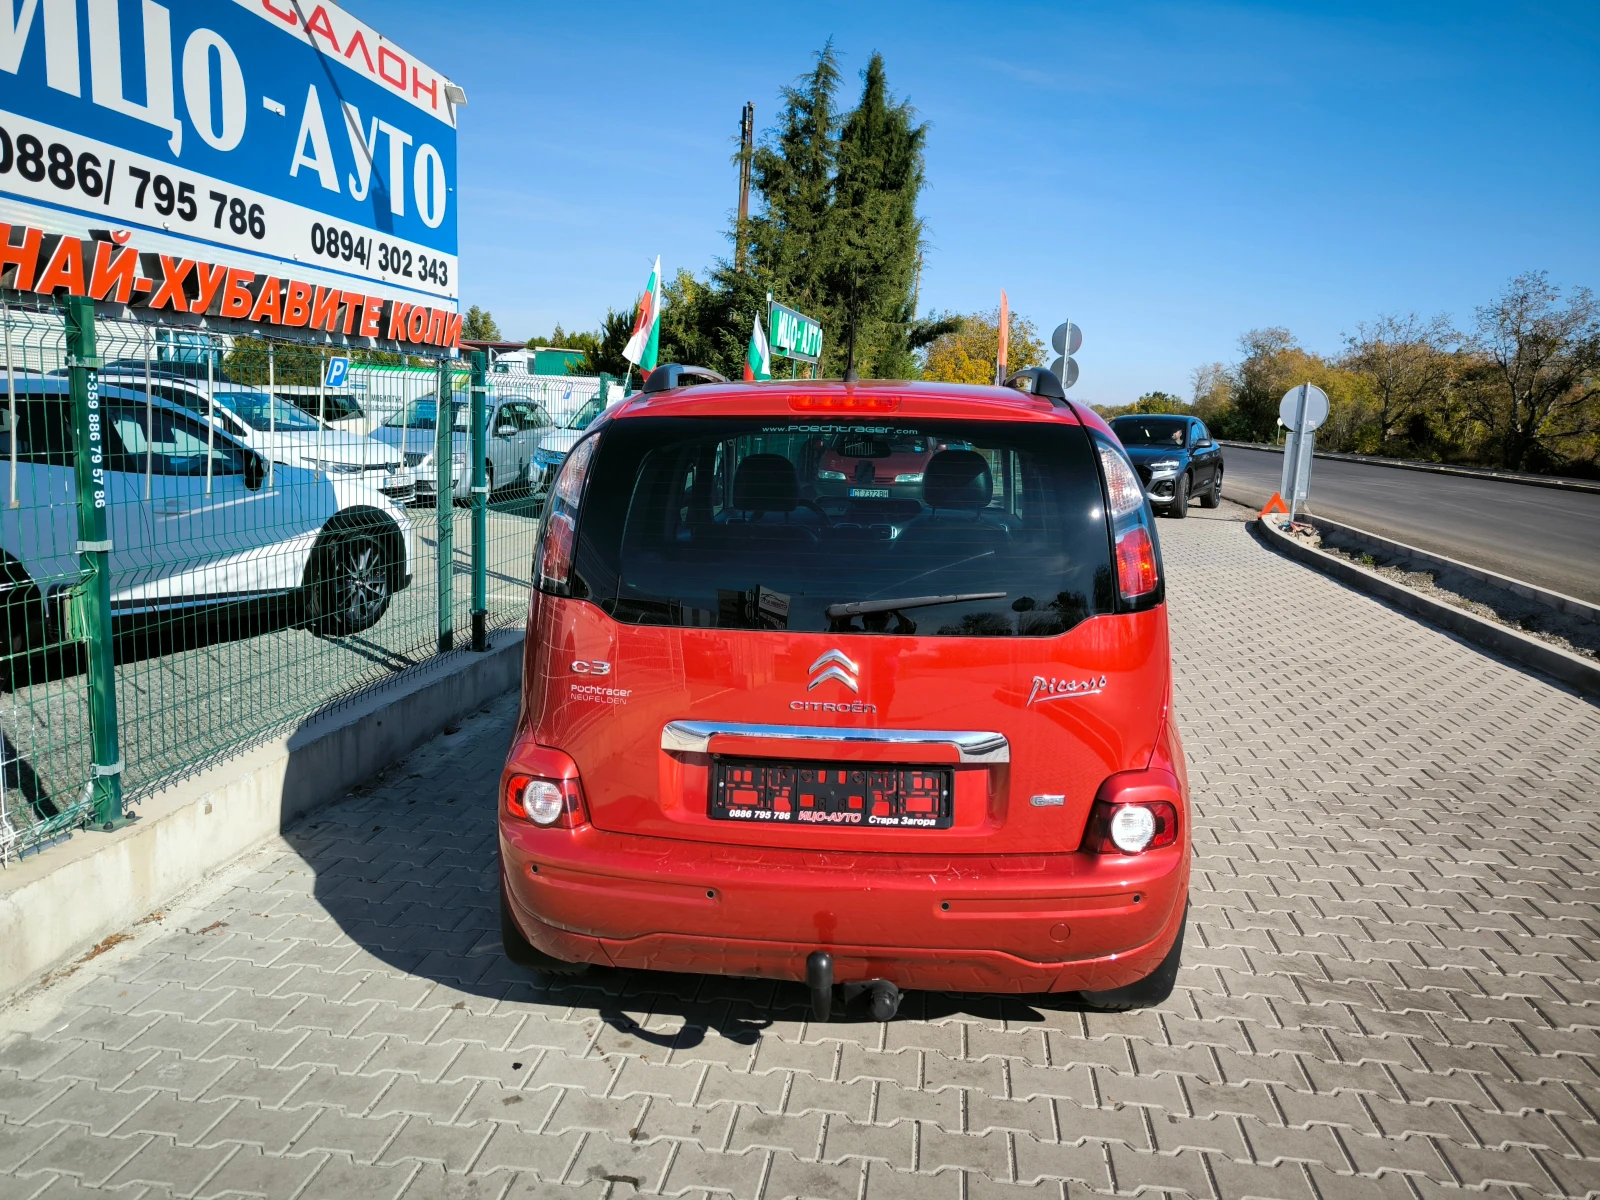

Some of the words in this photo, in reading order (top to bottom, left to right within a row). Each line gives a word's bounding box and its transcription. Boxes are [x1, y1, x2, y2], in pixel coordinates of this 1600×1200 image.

[129, 165, 198, 222] 795
[209, 190, 266, 240] 786
[311, 222, 372, 270] 0894/
[378, 243, 413, 278] 302
[418, 254, 448, 287] 343
[388, 300, 463, 348] КОЛИ
[87, 372, 98, 409] +359
[88, 413, 100, 441] 886
[91, 445, 102, 463] 79
[92, 468, 104, 485] 57
[94, 490, 105, 509] 86
[571, 660, 611, 675] C3
[1026, 675, 1107, 707] Picasso
[729, 809, 752, 818] 0886
[754, 811, 771, 819] 795
[773, 811, 790, 820] 786
[798, 811, 861, 823] ИЦО-АУТО
[868, 815, 898, 826] Стара
[901, 818, 936, 827] Загора
